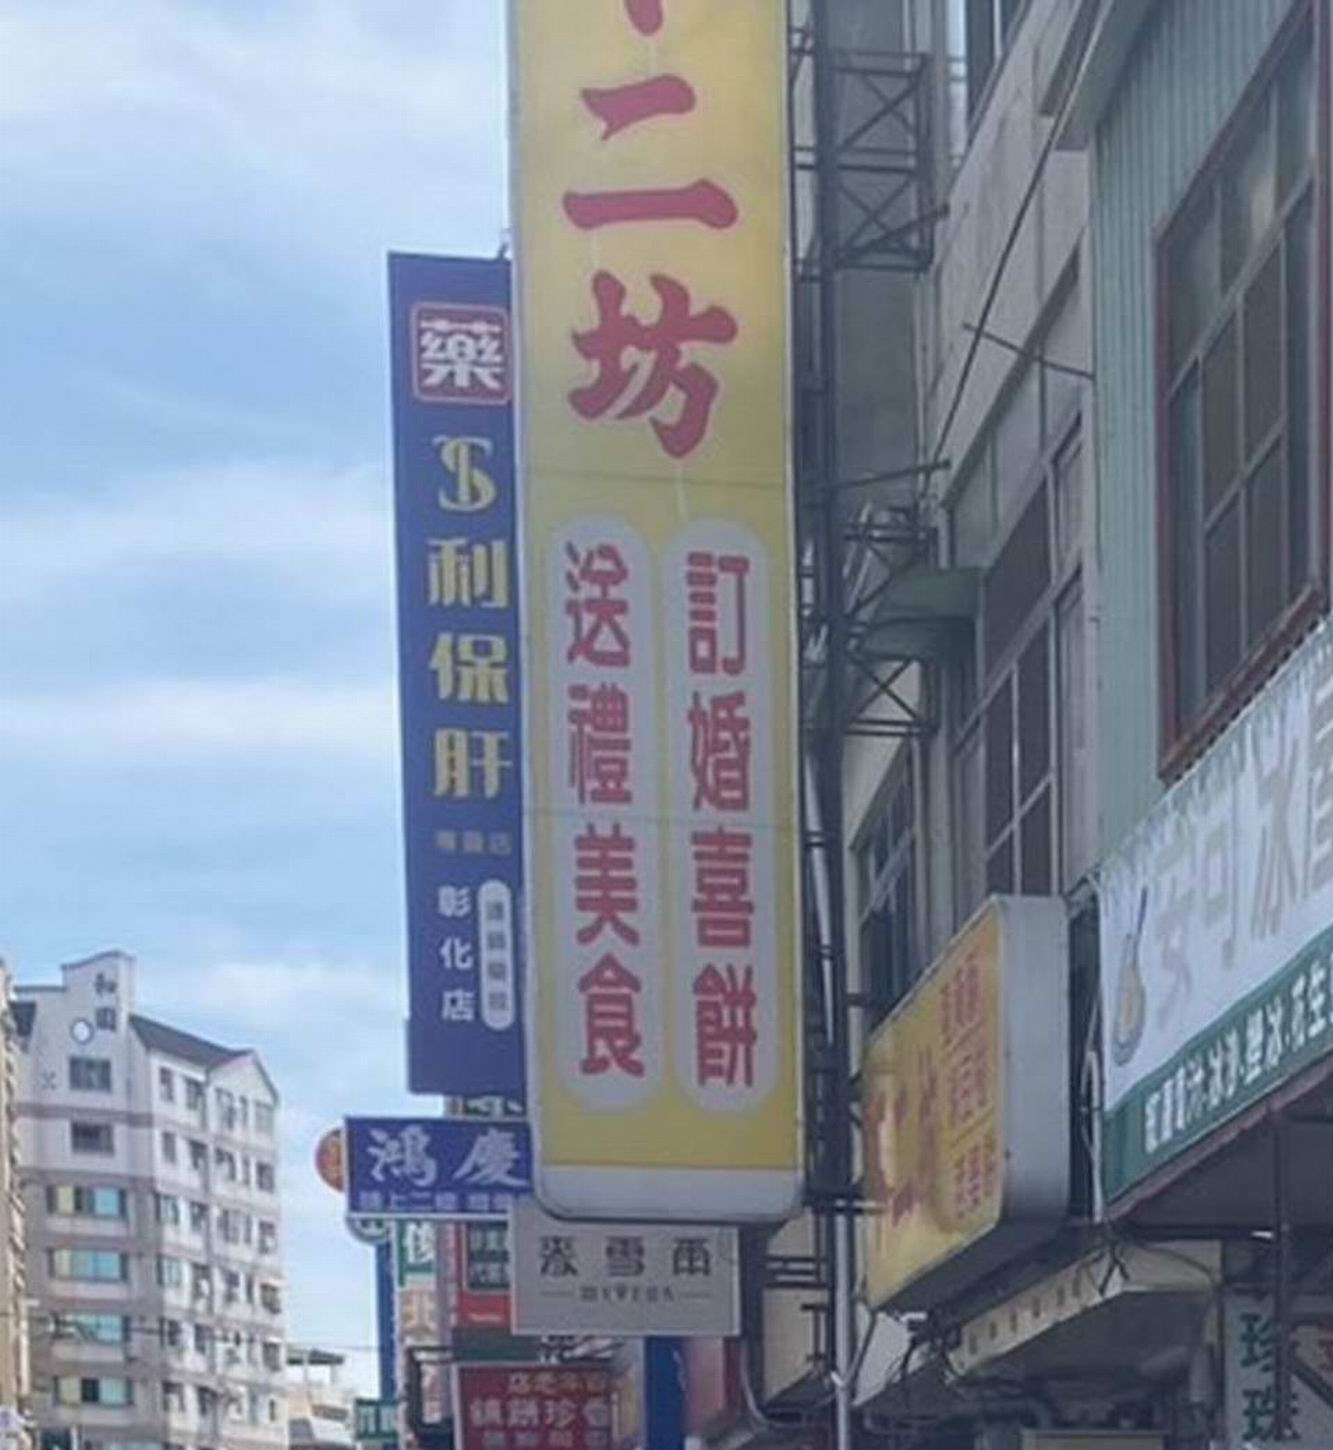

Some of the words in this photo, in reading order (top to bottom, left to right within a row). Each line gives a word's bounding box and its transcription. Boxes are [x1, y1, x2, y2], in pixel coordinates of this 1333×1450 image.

[419, 319, 505, 390] 藥
[561, 0, 739, 459] 二坊
[437, 884, 475, 1022] 彰化店
[564, 541, 646, 1078] 送禮美食
[685, 551, 758, 1087] 訂婚喜餅
